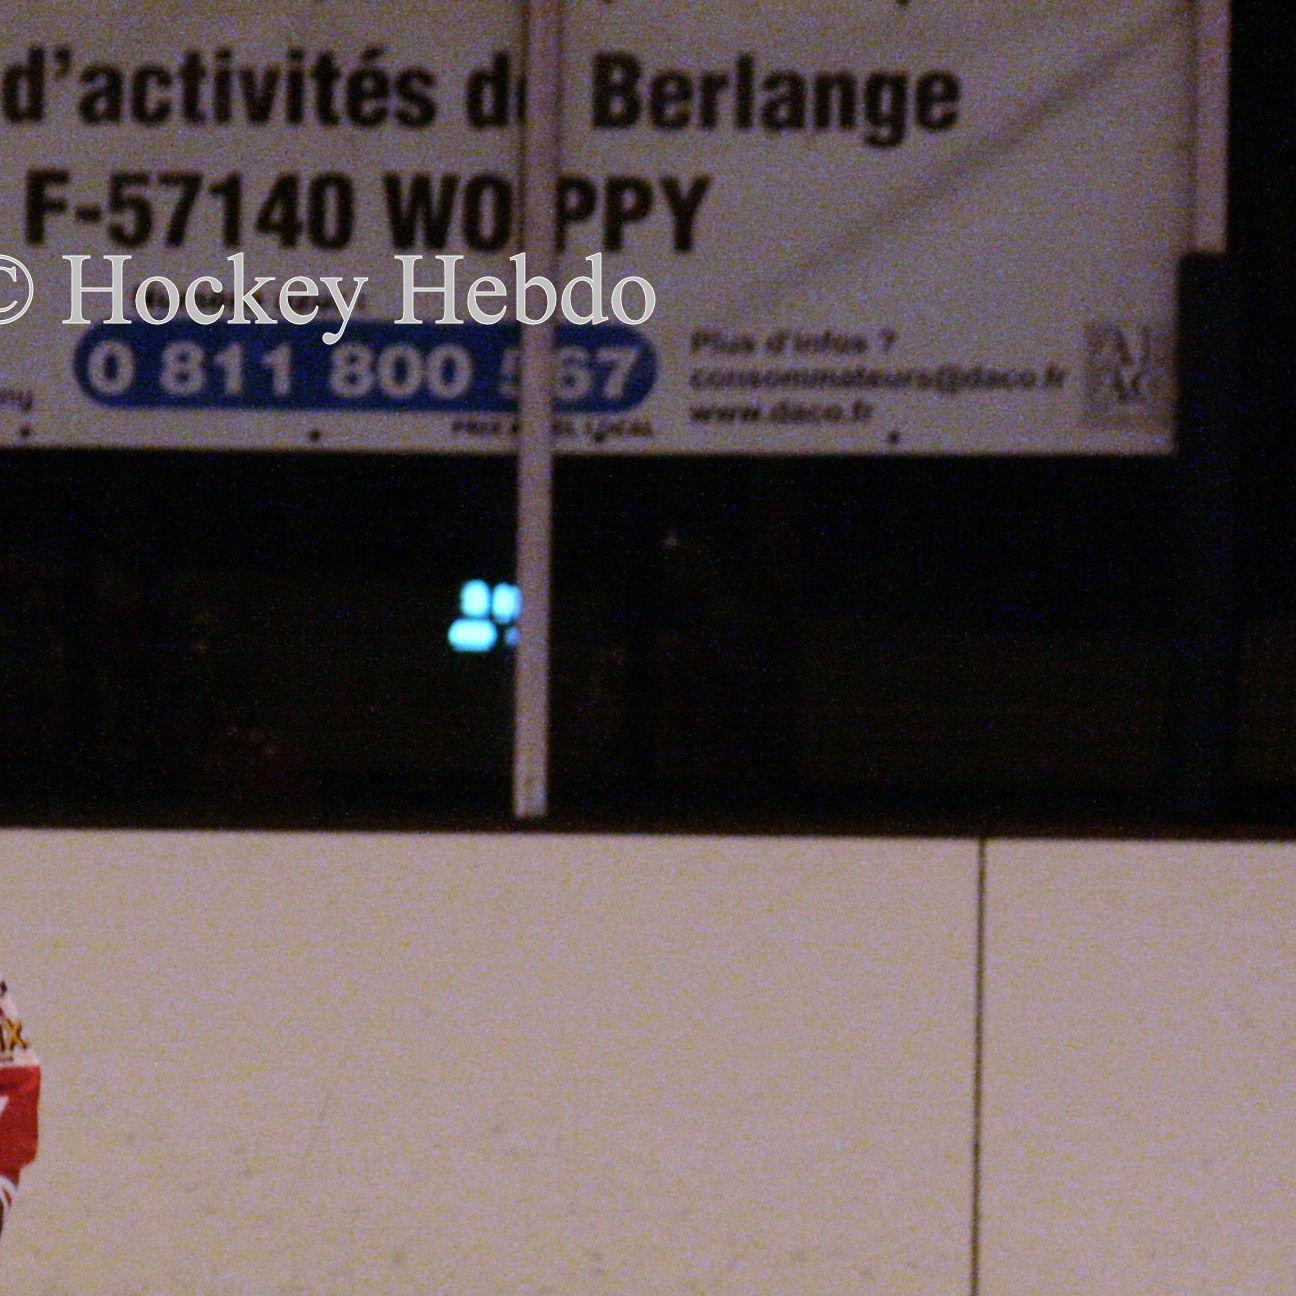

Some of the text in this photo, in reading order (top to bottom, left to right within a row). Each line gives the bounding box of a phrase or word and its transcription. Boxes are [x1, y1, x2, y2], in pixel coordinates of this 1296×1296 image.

[2, 43, 437, 128] d'activités
[467, 50, 526, 129] d
[592, 50, 963, 148] Berlange
[25, 168, 714, 254] F-57140 WOPPY
[85, 338, 137, 398] 0
[158, 340, 294, 398] 811
[327, 341, 475, 399] 800
